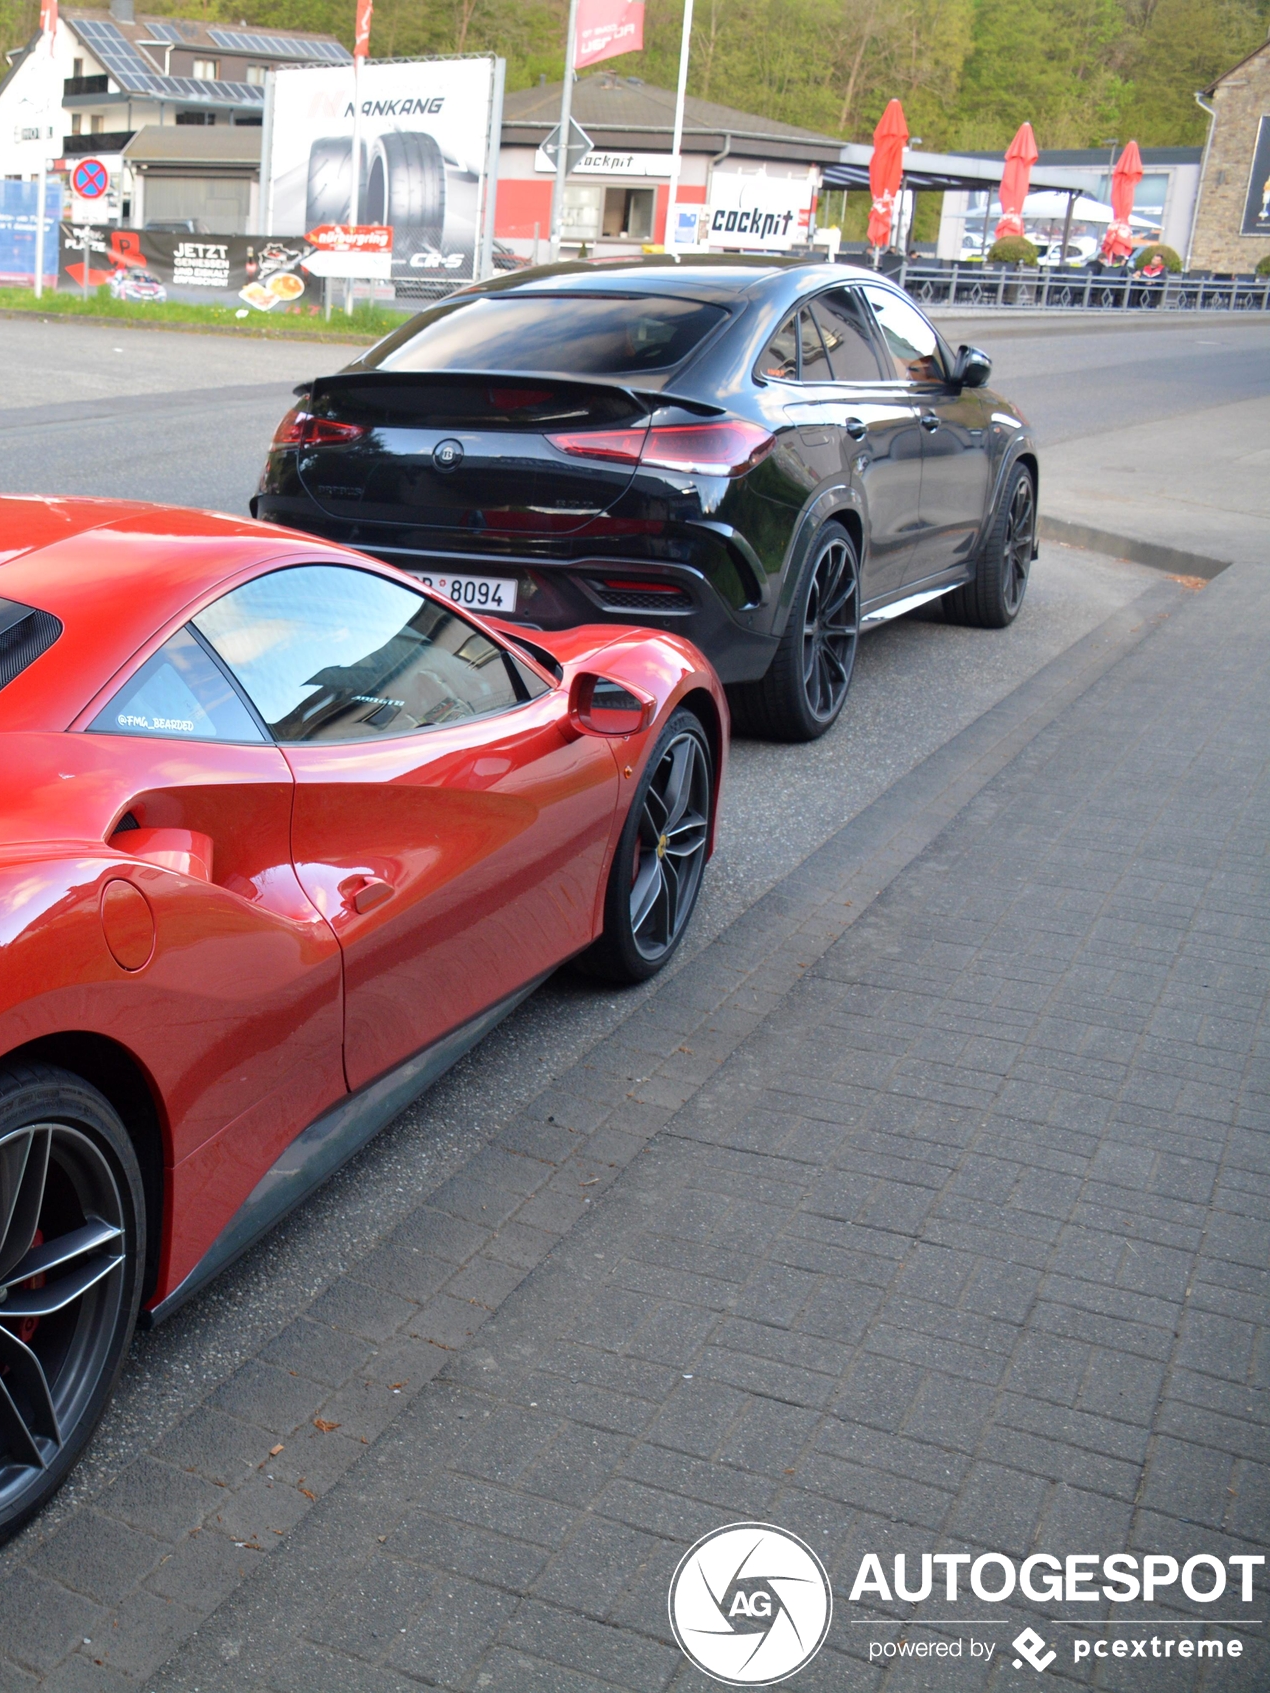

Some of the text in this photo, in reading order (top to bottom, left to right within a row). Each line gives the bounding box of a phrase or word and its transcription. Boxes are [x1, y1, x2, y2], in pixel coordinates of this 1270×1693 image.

[344, 97, 445, 118] NANKANG
[579, 155, 634, 169] ockpit
[712, 207, 793, 239] cockpit
[318, 231, 389, 247] nürburgring
[173, 242, 228, 259] JETZT
[173, 257, 230, 270] GENIESSEN
[450, 579, 503, 607] 8094
